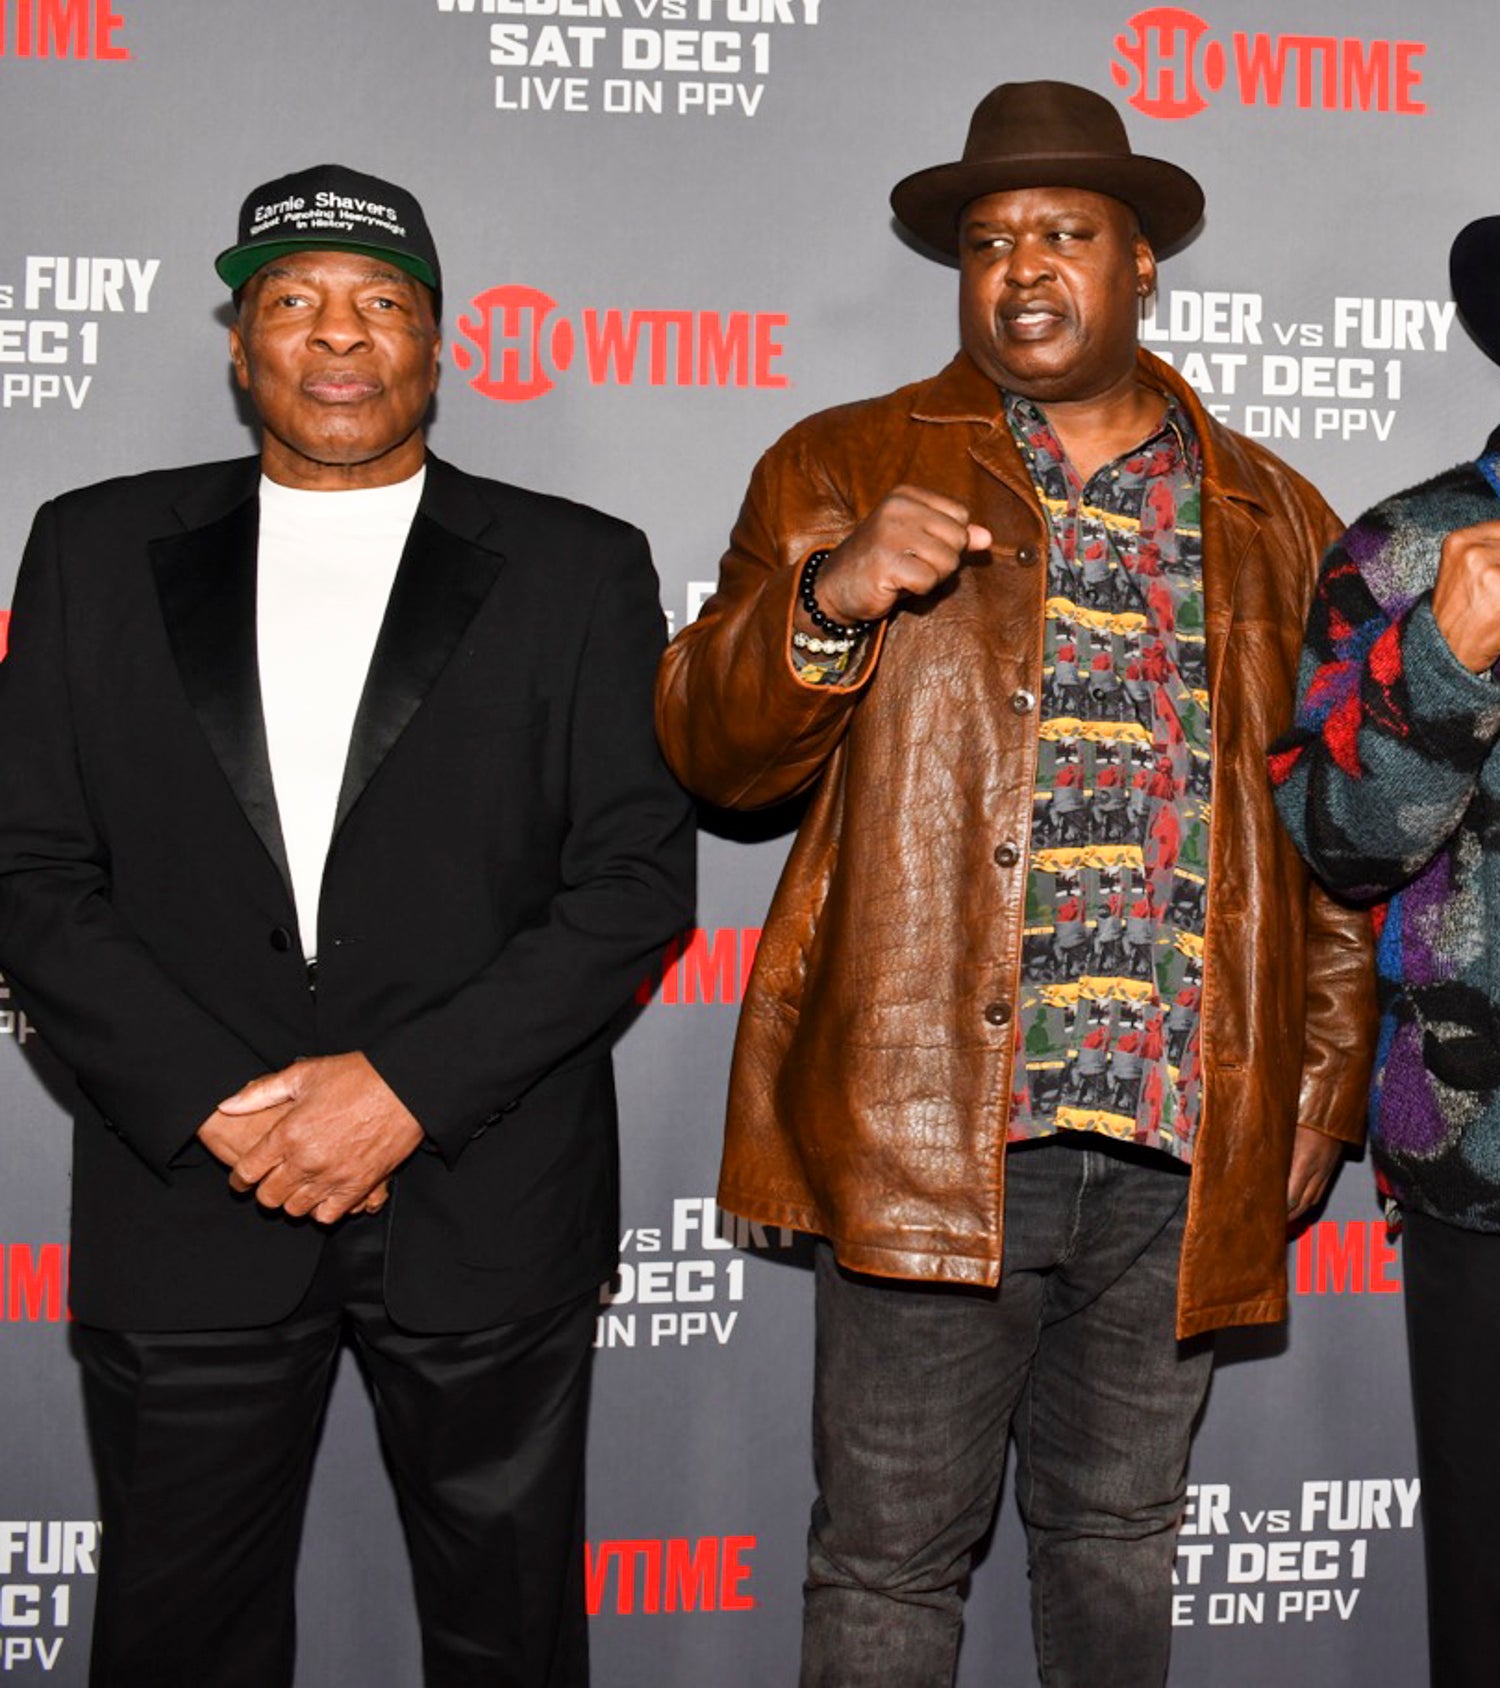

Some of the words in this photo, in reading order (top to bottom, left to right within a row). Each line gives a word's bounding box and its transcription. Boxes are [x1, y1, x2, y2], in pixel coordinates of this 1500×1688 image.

[0, 0, 131, 60] IME
[491, 24, 605, 67] SAT
[623, 29, 740, 72] DEC
[752, 33, 769, 73] 1
[1109, 7, 1427, 120] SHOWTIME
[496, 76, 588, 111] LIVE
[604, 80, 661, 113] ON
[679, 82, 764, 116] PPV
[254, 195, 305, 222] Earnie
[315, 192, 397, 222] Shavers
[26, 257, 160, 312] FURY
[1139, 291, 1262, 344] LDER
[1335, 298, 1454, 351] FURY
[80, 322, 97, 364] 1
[451, 284, 790, 404] SHOWTIME
[4, 374, 91, 409] PPV
[1153, 352, 1247, 394] AT
[1263, 355, 1374, 398] DEC
[1385, 360, 1400, 399] 1
[1245, 406, 1300, 438] ON
[1315, 408, 1395, 441] PPV
[726, 1260, 743, 1300] 1
[652, 1312, 737, 1346] PPV
[1301, 1479, 1420, 1531] FURY
[0, 1521, 101, 1573] FUR
[1228, 1541, 1339, 1582] DEC
[1351, 1540, 1366, 1578] 1
[52, 1585, 69, 1626] 1
[1209, 1593, 1264, 1624] ON
[1279, 1589, 1359, 1622] PPV
[0, 1638, 63, 1669] PV
